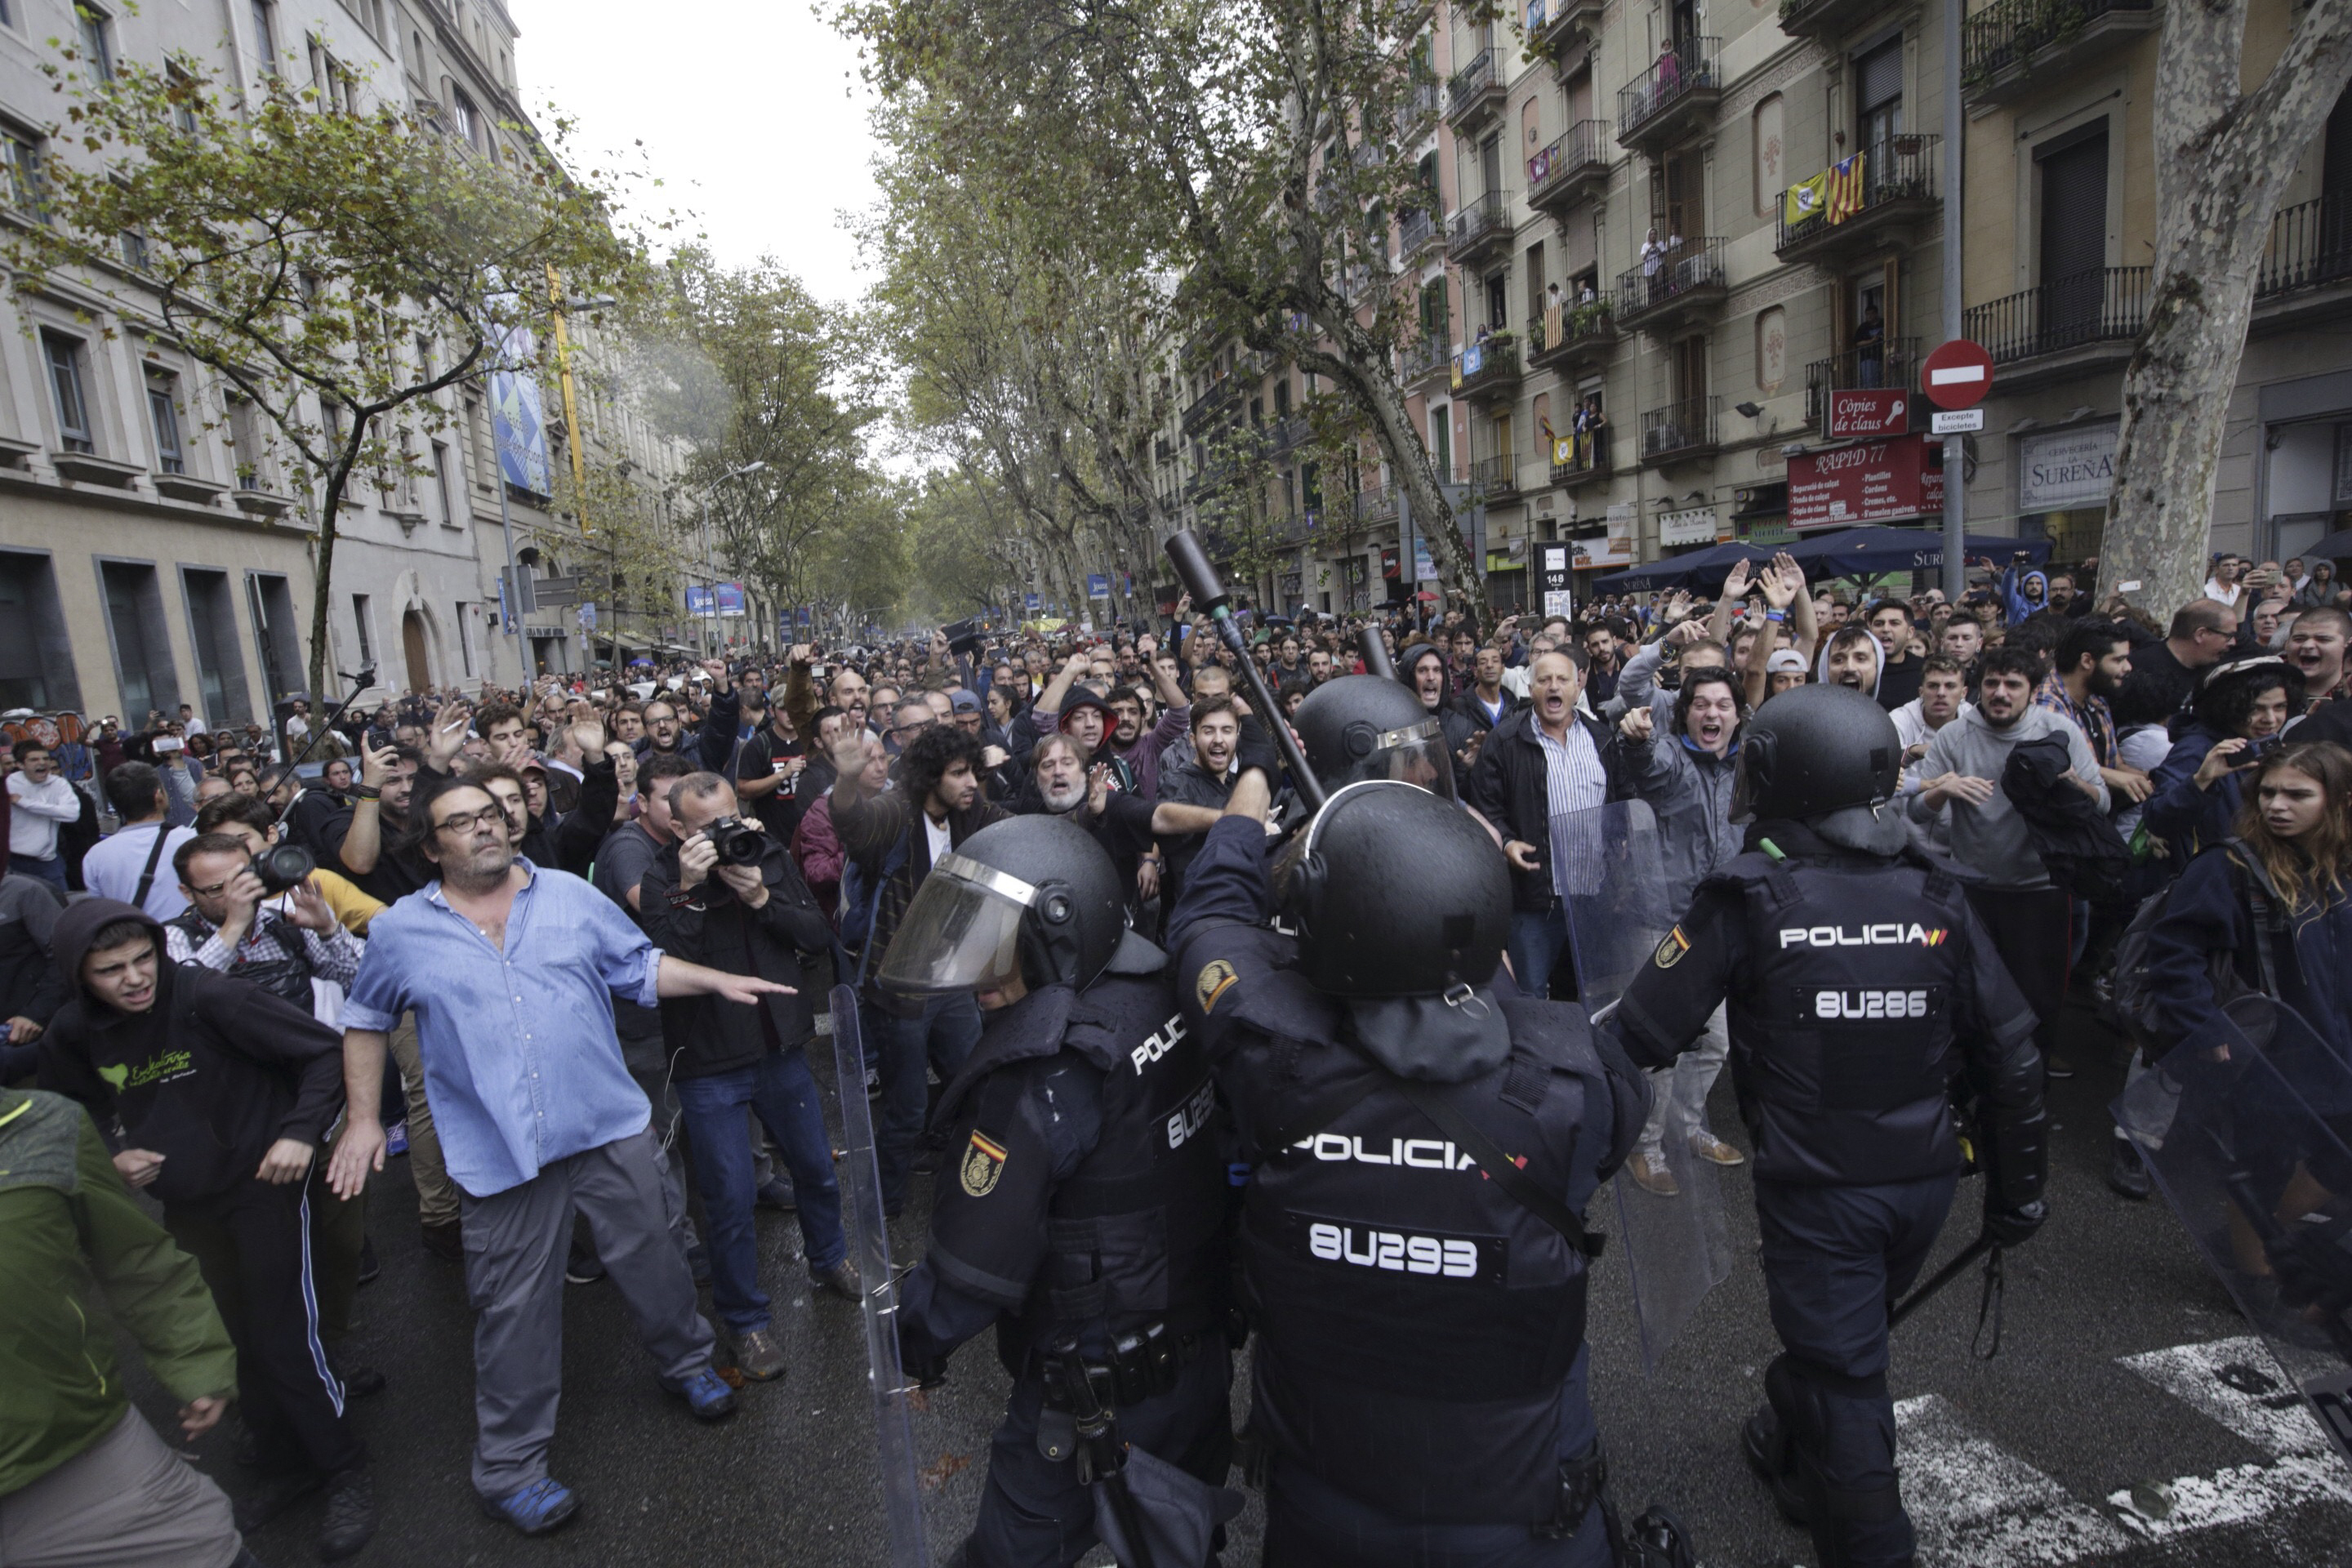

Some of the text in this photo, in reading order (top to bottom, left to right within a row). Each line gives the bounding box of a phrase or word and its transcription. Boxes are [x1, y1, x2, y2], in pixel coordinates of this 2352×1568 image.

[1838, 397, 1877, 417] Còpies
[1834, 415, 1882, 432] de claus
[1941, 412, 1974, 421] Excepte
[1938, 421, 1977, 431] bicicletes
[1870, 444, 1886, 464] 77
[2048, 442, 2098, 457] CERVECERÍA
[1864, 471, 1891, 483] Plantilles
[2032, 453, 2114, 488] SUREÑA
[1793, 479, 1839, 494] Reparació de calçat
[1864, 484, 1887, 494] Cordons
[1793, 492, 1829, 505] Venda de calçat
[1886, 495, 1897, 504] etc.
[1927, 486, 1944, 502] calça
[1793, 507, 1806, 516] Còpia
[1806, 506, 1813, 514] de
[1813, 505, 1827, 513] claus
[1864, 507, 1891, 519] S'esmolen
[1891, 505, 1916, 516] ganivets
[1793, 515, 1829, 527] Comandaments
[1572, 545, 1588, 555] iste-
[1547, 573, 1565, 585] 148
[1780, 923, 1929, 949] POLICIA
[1815, 990, 1927, 1019] 8U286
[1131, 1012, 1187, 1076] POLIC
[1310, 1223, 1477, 1278] 8U293
